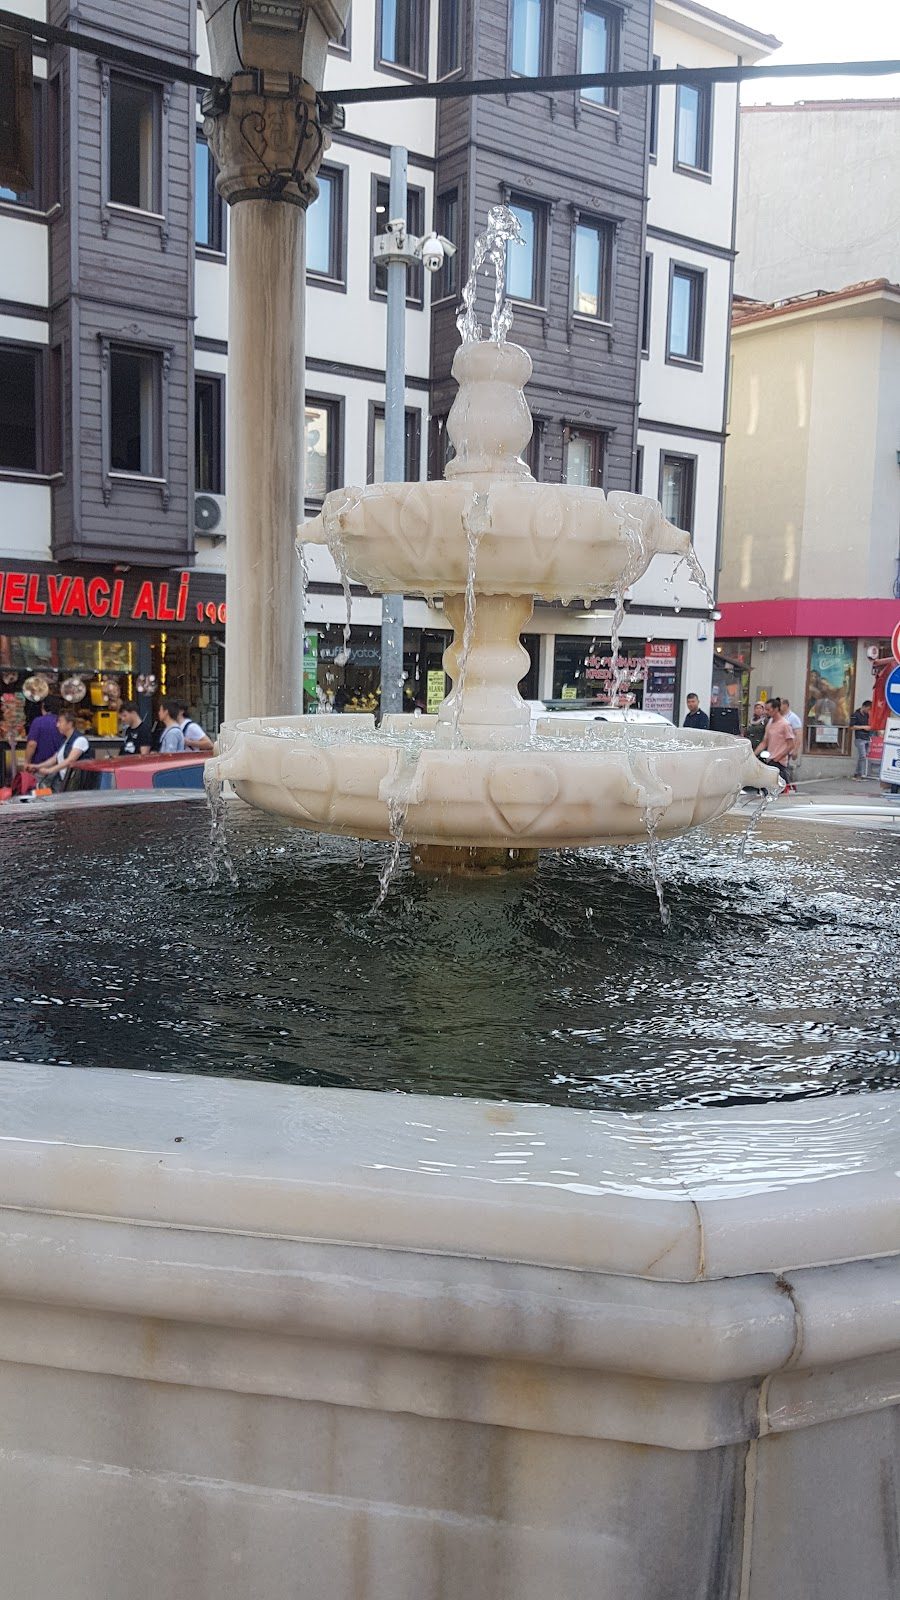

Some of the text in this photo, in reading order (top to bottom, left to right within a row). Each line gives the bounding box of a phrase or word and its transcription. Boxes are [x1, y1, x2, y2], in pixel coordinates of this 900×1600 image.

[0, 571, 124, 618] ELVACI
[131, 572, 190, 621] ALİ
[817, 643, 844, 656] Penti
